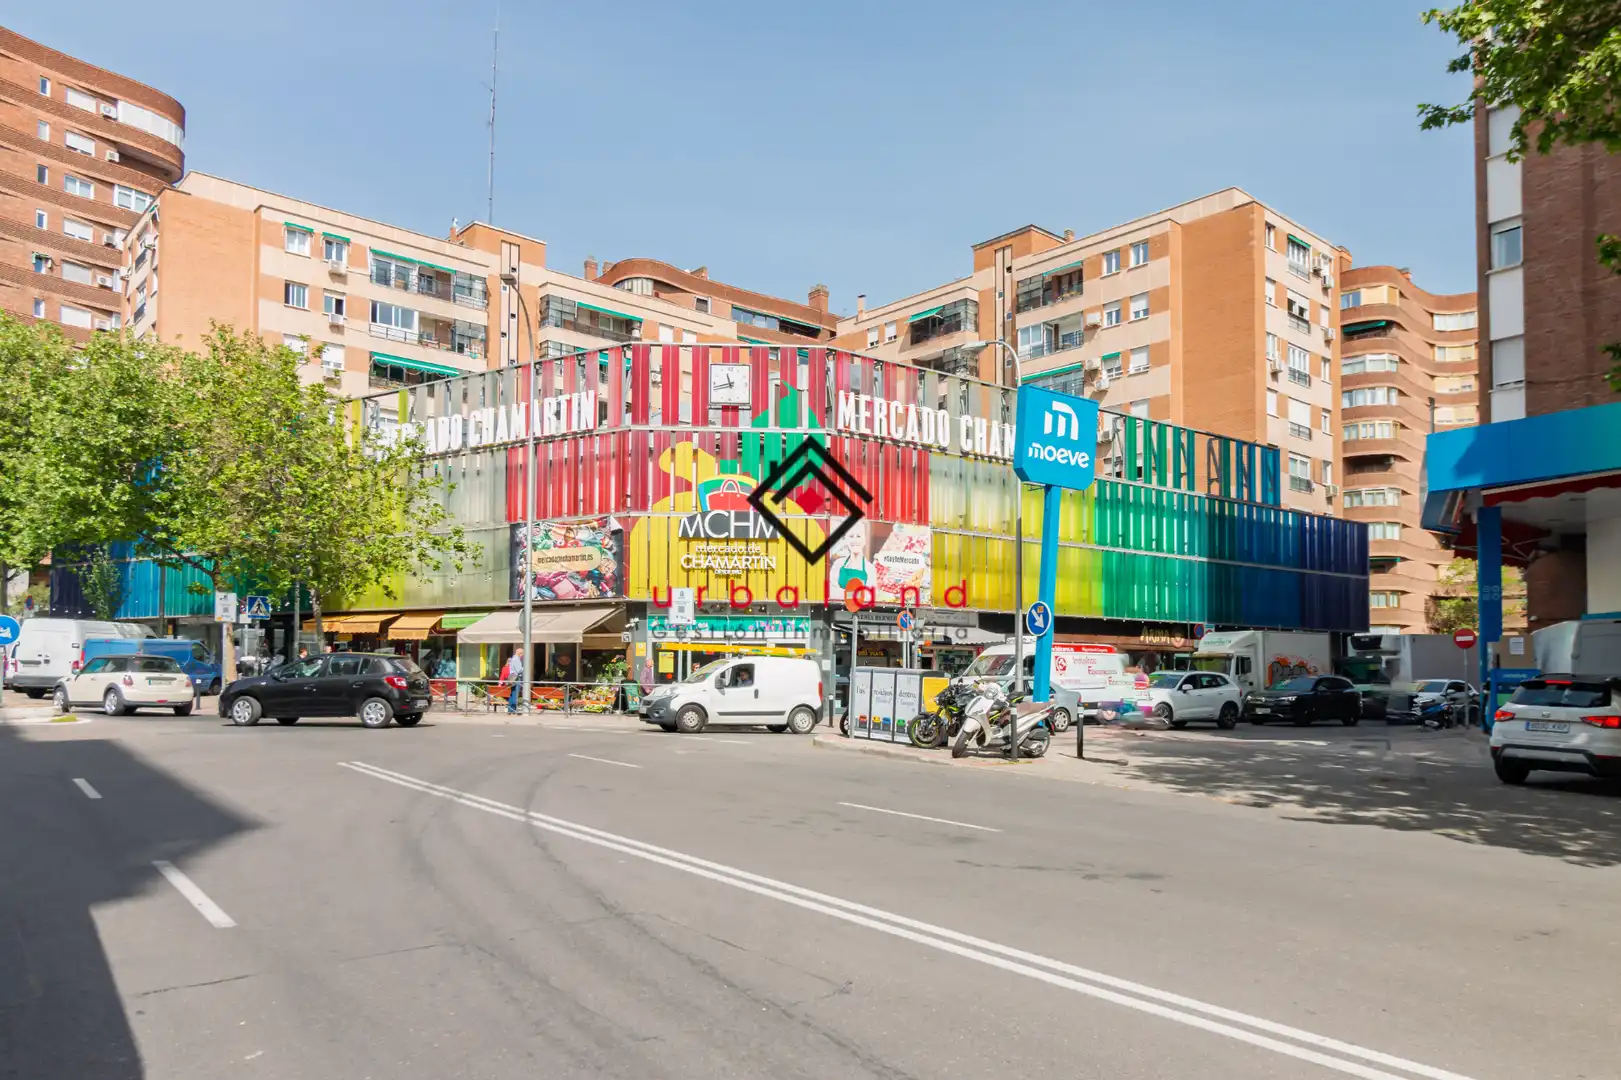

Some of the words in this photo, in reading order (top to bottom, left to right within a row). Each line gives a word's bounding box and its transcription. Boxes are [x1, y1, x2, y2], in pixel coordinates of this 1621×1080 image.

[837, 389, 950, 448] MERCADO
[1028, 442, 1089, 468] moeve
[679, 508, 780, 538] MCHM
[695, 542, 745, 553] mercado
[748, 541, 760, 553] de
[680, 553, 776, 569] CHAMARTÍN
